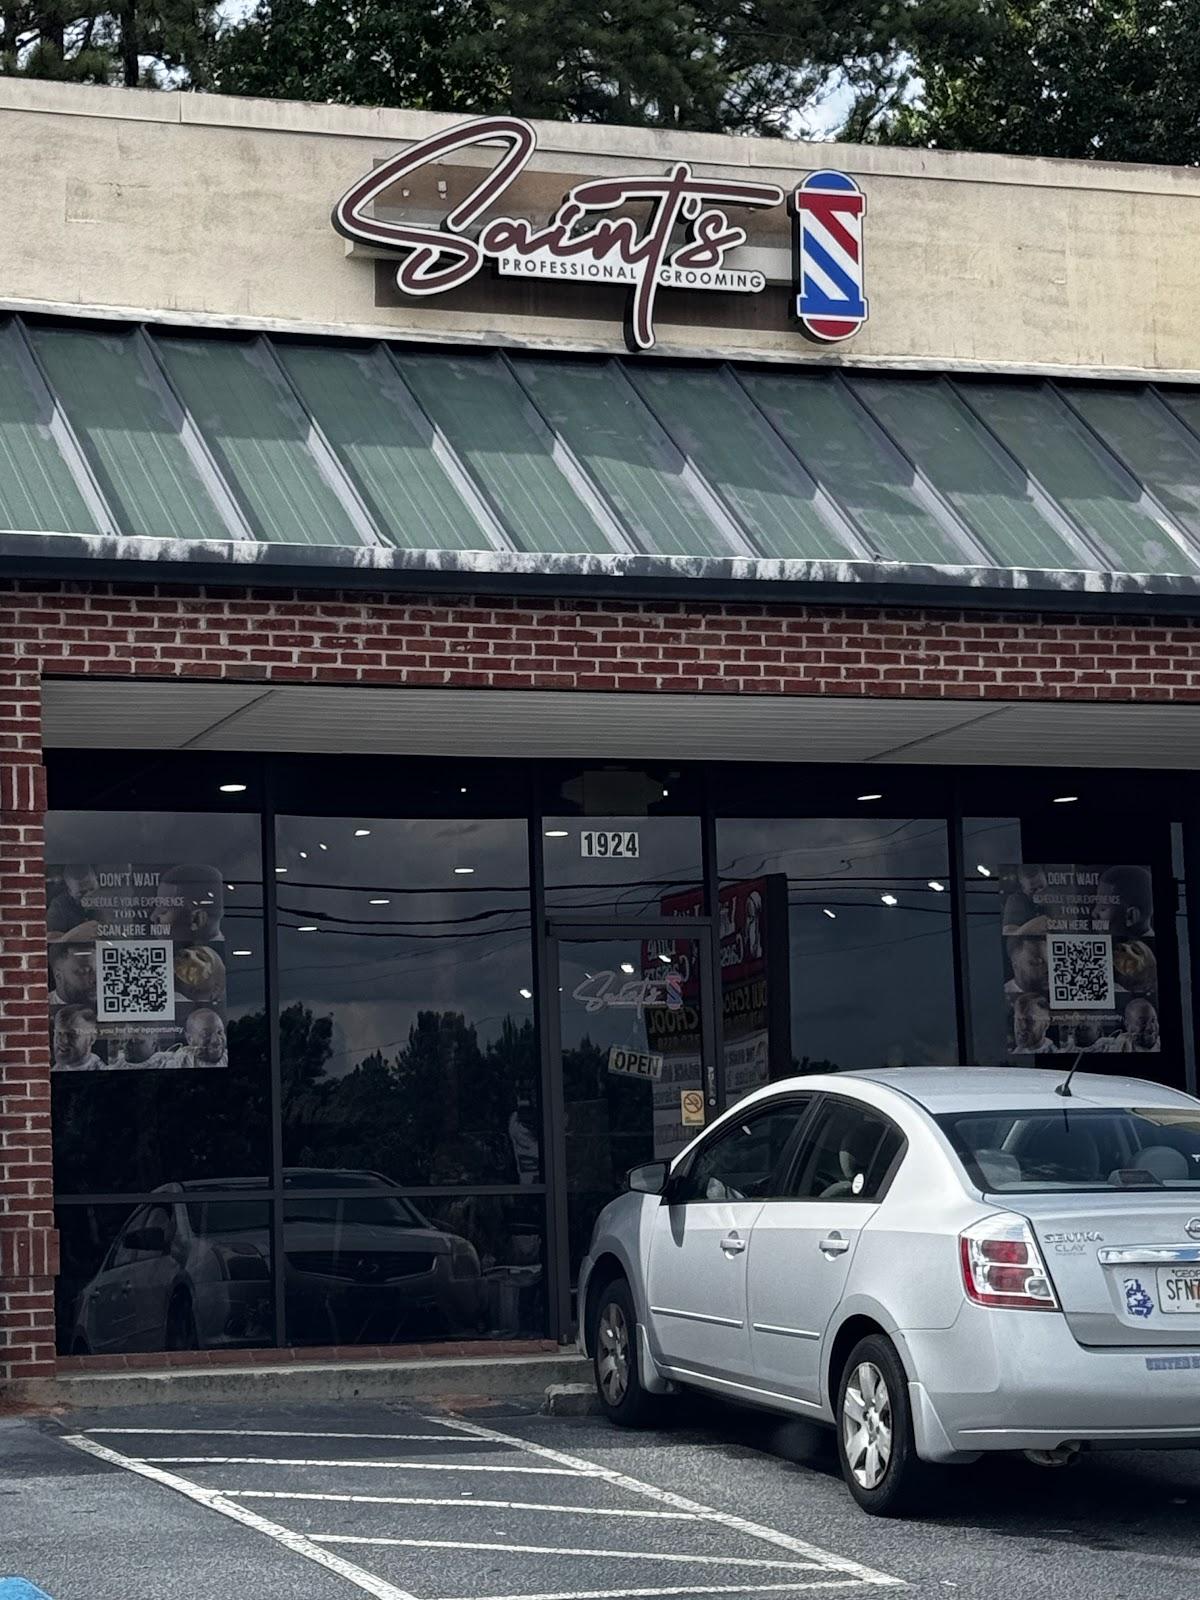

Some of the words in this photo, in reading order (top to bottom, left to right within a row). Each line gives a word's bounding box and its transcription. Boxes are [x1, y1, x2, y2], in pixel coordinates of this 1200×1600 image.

[502, 257, 637, 280] PROFESSIONAL
[659, 269, 762, 288] GROOMING
[583, 832, 637, 856] 1924
[99, 872, 130, 888] DON'T
[133, 872, 160, 888] WAIT
[1047, 872, 1074, 886] DON'T
[1076, 872, 1100, 886] WAIT
[113, 909, 148, 919] TODAY
[97, 924, 121, 937] SCAN
[122, 924, 146, 937] HERE
[150, 924, 171, 937] NOW
[614, 1052, 659, 1076] OPEN
[1044, 1231, 1104, 1244] SENTRA
[1055, 1244, 1086, 1252] CLAY
